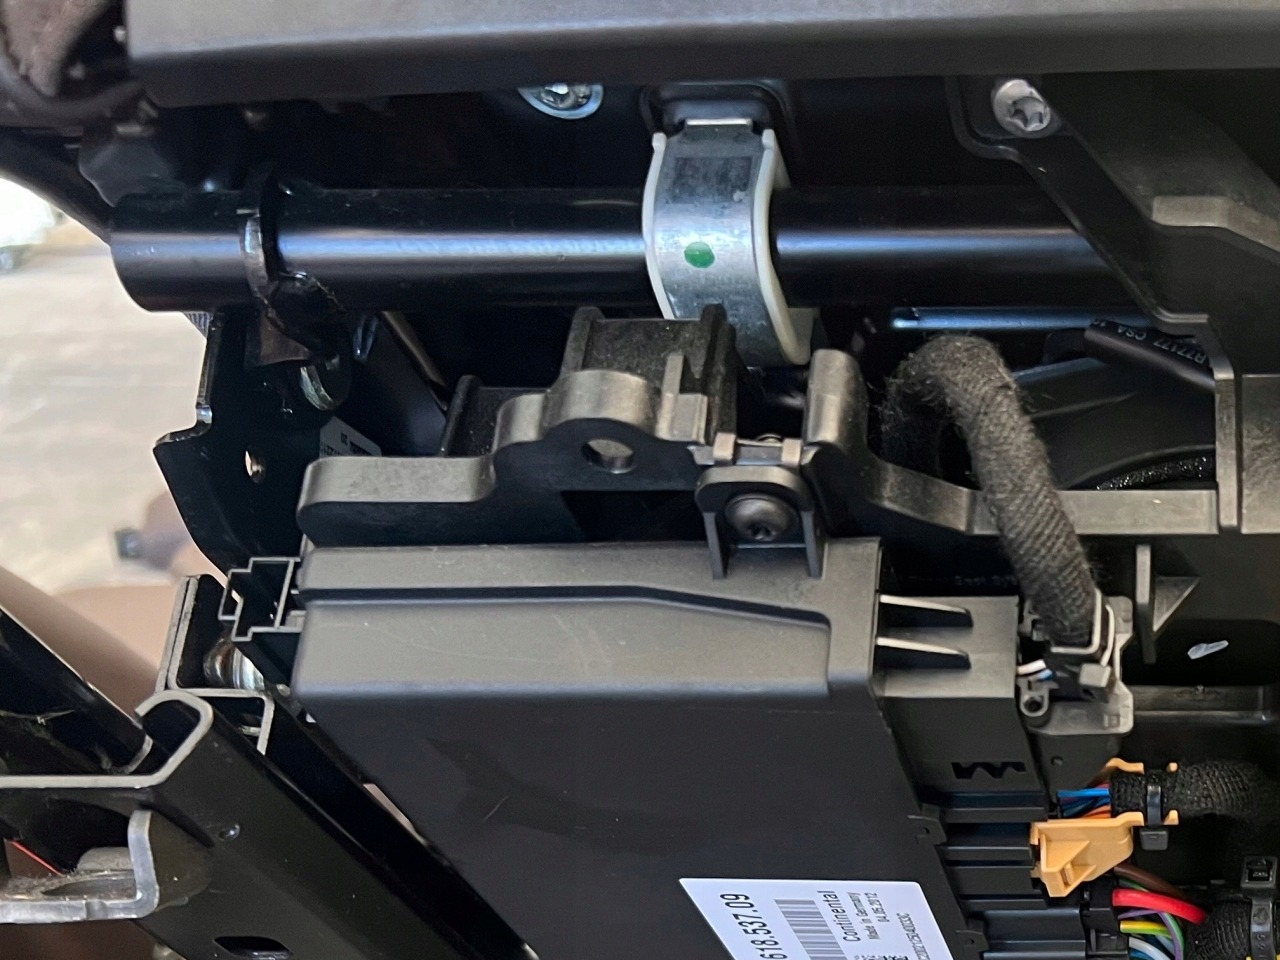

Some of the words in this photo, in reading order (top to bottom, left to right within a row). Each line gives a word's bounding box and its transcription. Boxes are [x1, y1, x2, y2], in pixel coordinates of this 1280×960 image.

[816, 890, 862, 941] Continental
[844, 892, 871, 916] Germany
[862, 925, 880, 939] Made
